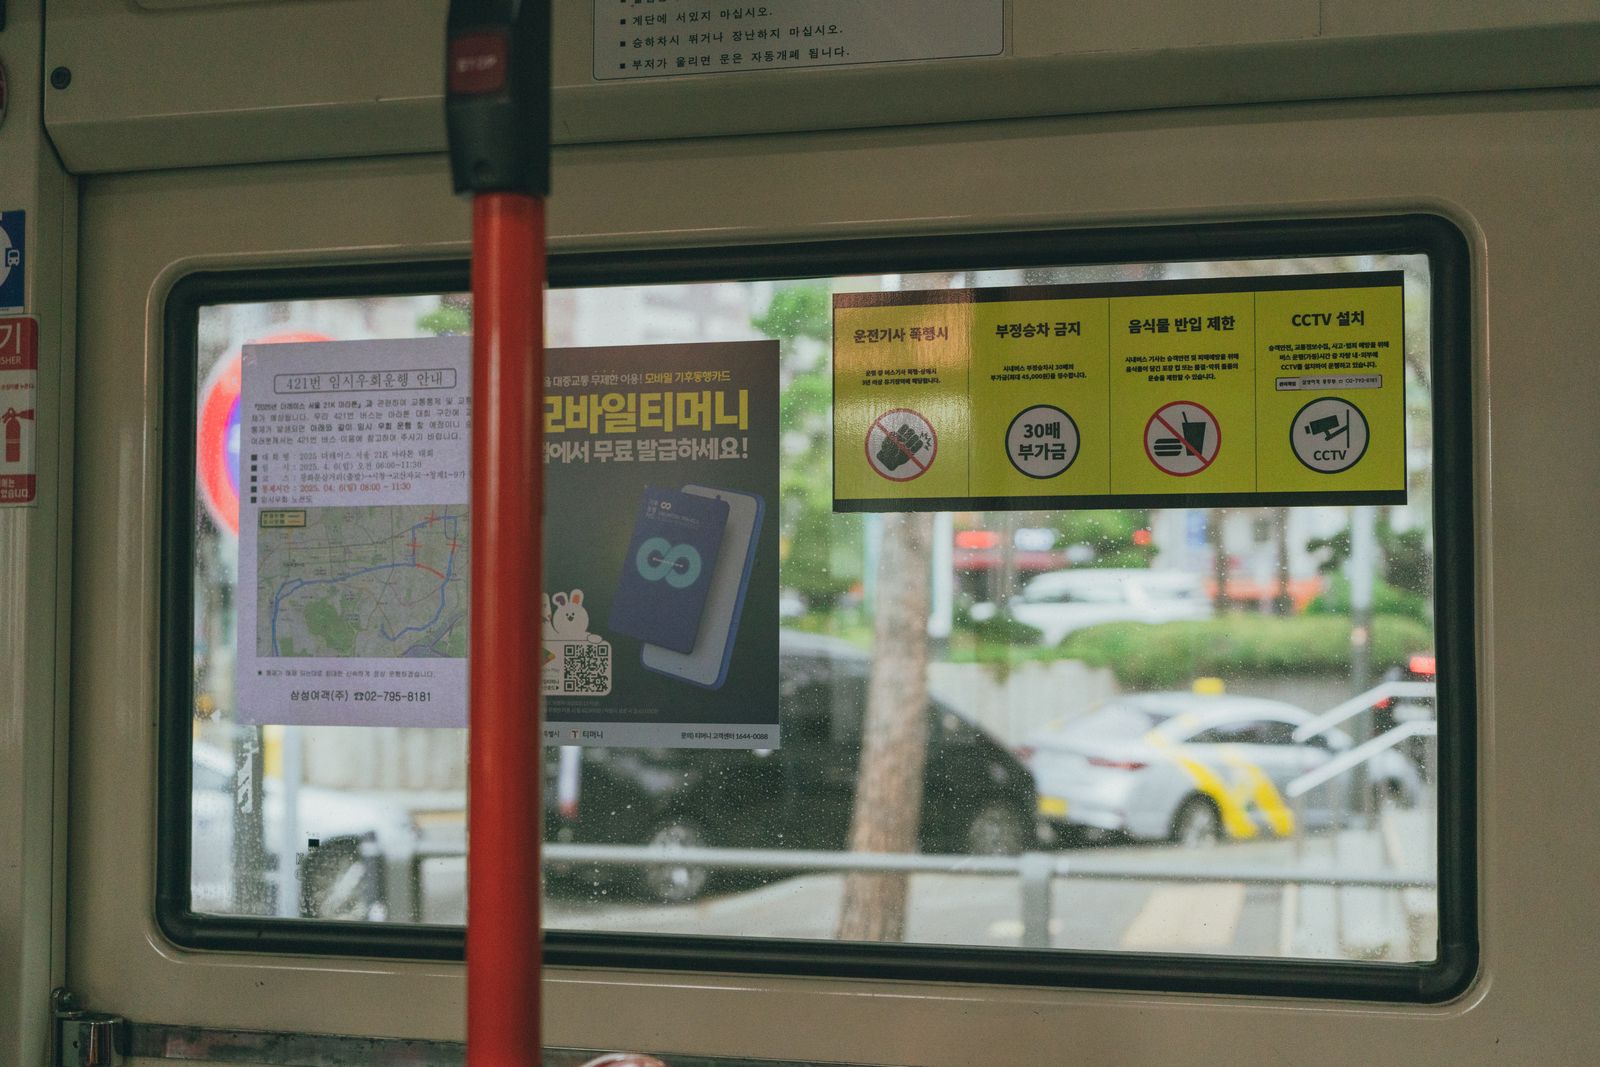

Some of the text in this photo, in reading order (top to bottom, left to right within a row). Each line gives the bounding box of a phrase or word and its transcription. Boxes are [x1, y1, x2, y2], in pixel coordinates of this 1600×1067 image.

[633, 7, 773, 26] 계단에 서있지 마십시오.
[633, 24, 842, 49] 승하차시 뛰거나 장난하지 마십시오.
[632, 58, 667, 71] 부저가
[676, 55, 711, 68] 울리면
[720, 52, 743, 65] 문은
[808, 46, 850, 59] 됩니다.
[1128, 315, 1235, 334] 음식물 반입 제한
[1291, 310, 1365, 327] CCTV 설치
[853, 326, 949, 344] 운전기사 폭행시
[995, 320, 1081, 339] 부정승차 금지
[287, 371, 443, 390] 421번 임시우회운행 안내
[553, 375, 590, 388] 대중교통
[591, 373, 618, 386] 무제한
[620, 372, 643, 385] 이용!
[645, 372, 672, 385] 모바일
[674, 370, 731, 384] 기후동행카드
[1023, 422, 1061, 439] 30배
[544, 437, 748, 464] 에서 무료 발급하세요!
[1018, 443, 1067, 461] 부가금
[1313, 449, 1348, 462] CCTV
[290, 690, 432, 703] 삼성여객(주) 02-795-8181
[582, 730, 604, 739] 티머니
